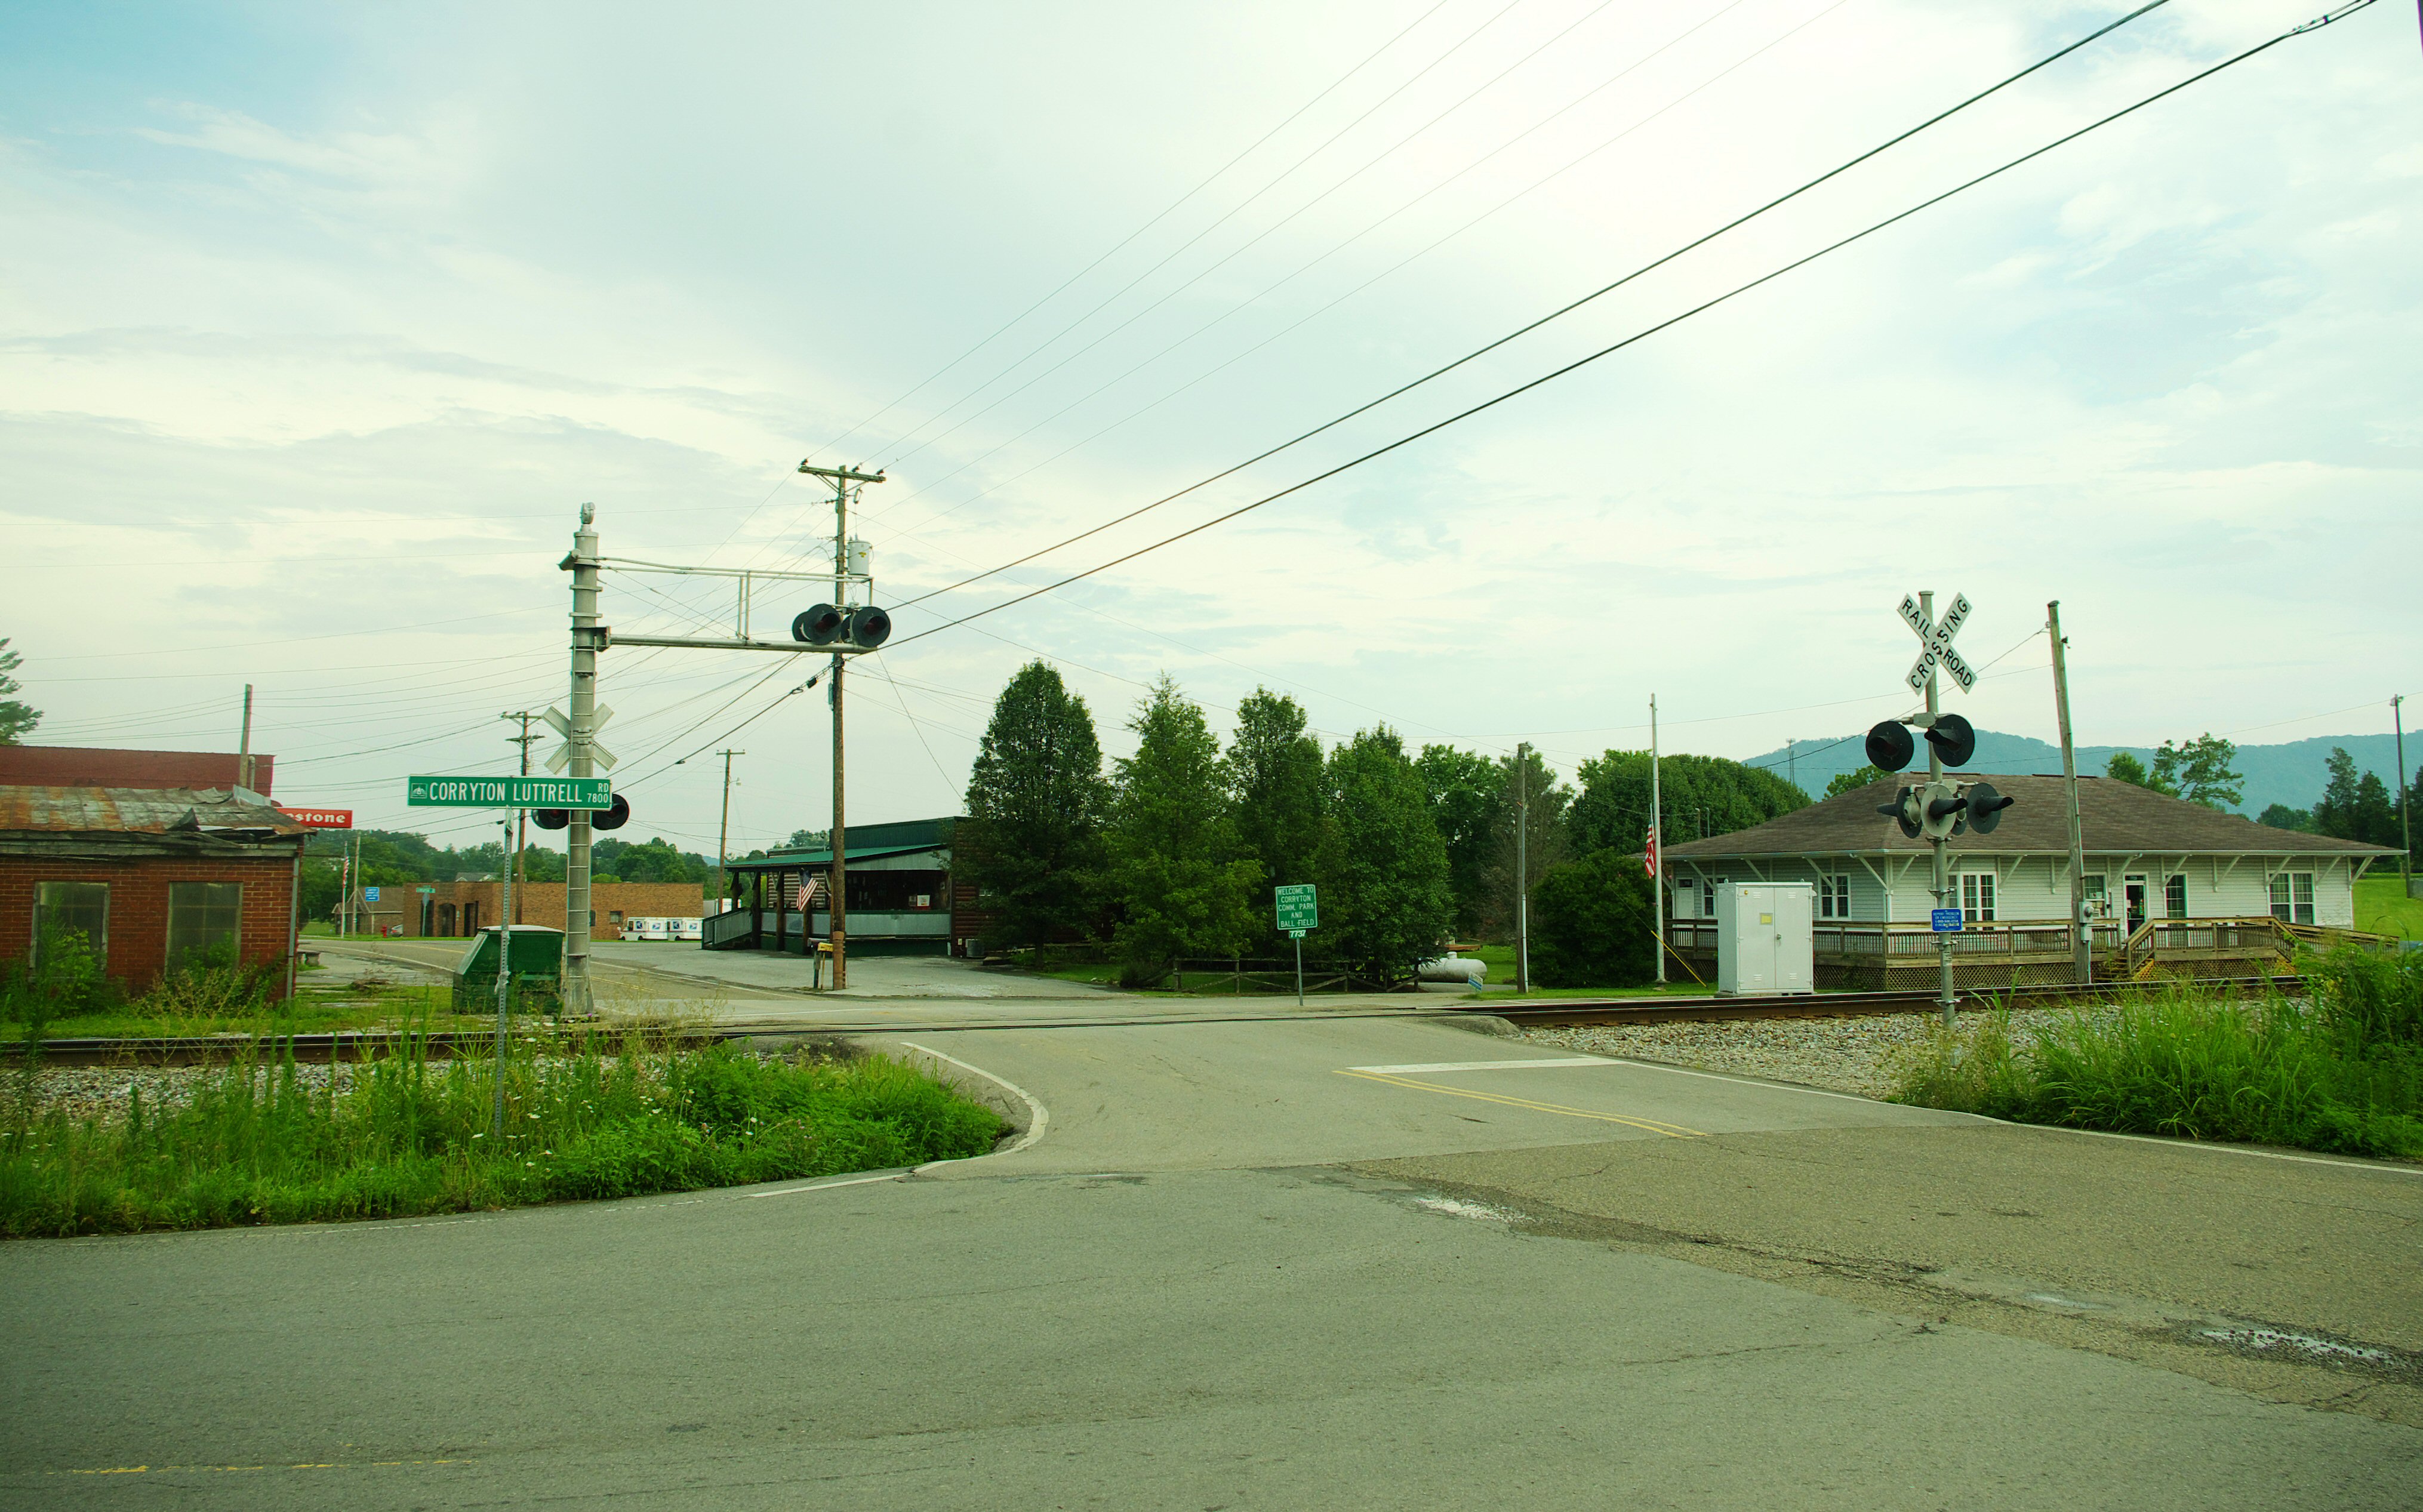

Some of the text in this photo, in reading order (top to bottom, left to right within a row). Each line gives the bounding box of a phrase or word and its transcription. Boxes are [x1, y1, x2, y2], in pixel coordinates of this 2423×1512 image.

[1911, 599, 1969, 689] CROSSING
[429, 782, 609, 803] CORRYTON LUTTRELL RD
[587, 793, 609, 803] 7800
[1297, 918, 1314, 926] FIELD
